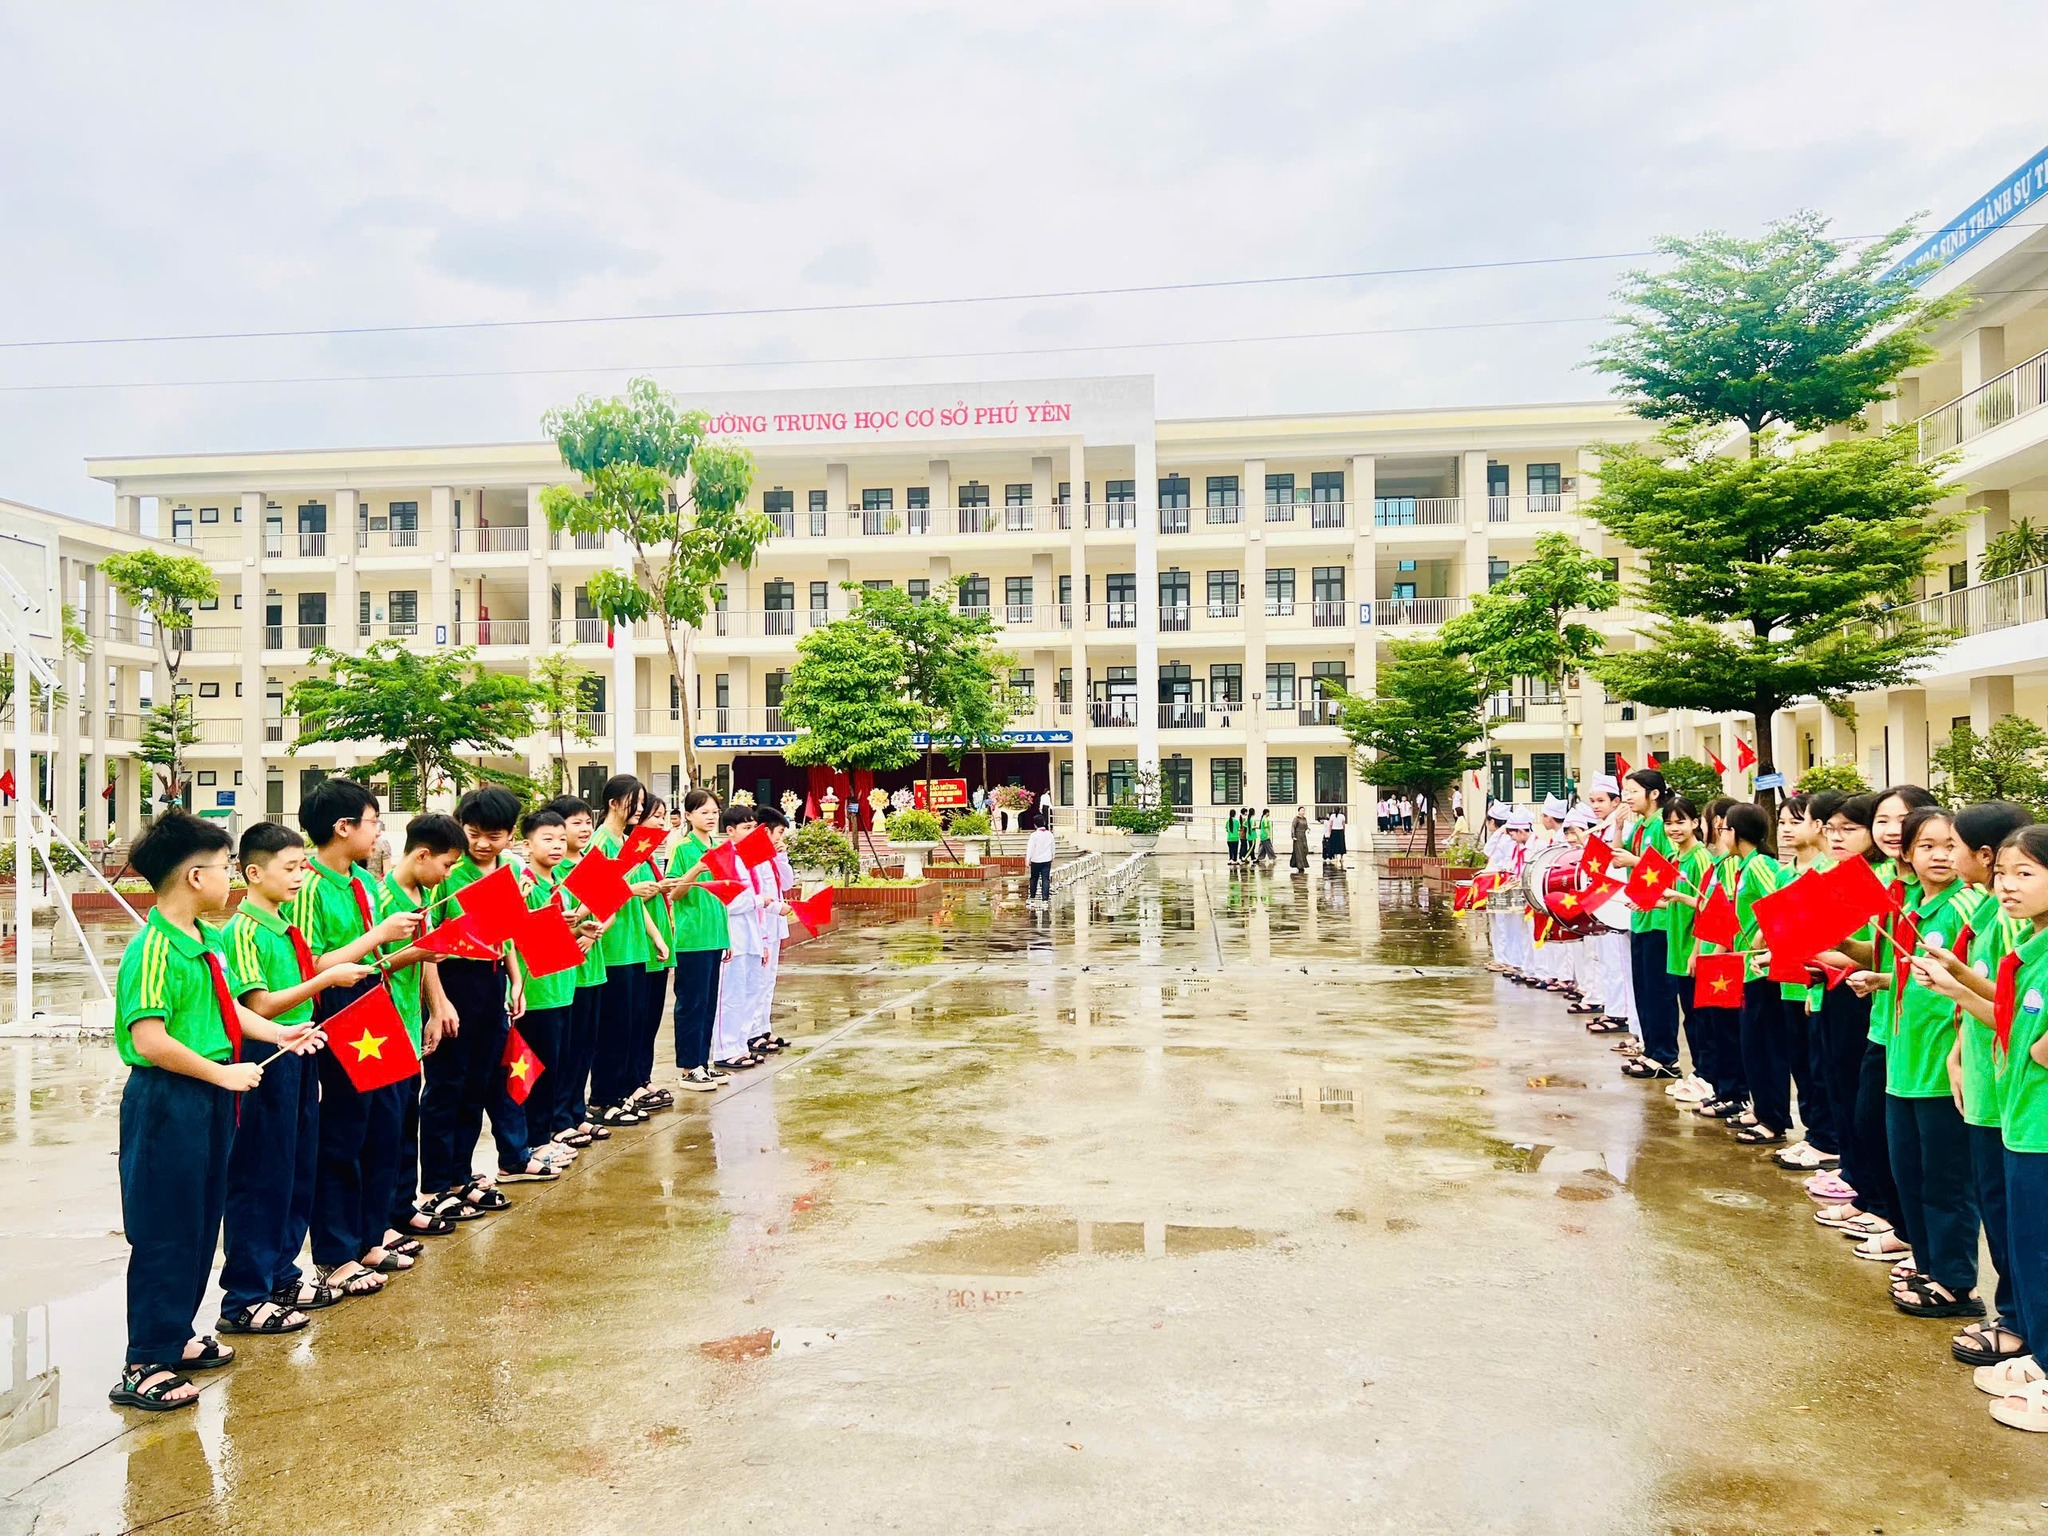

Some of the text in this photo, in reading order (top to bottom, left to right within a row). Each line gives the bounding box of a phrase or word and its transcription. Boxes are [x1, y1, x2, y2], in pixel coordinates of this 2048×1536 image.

[1941, 222, 1967, 255] SINH
[1969, 188, 2012, 239] THÀNH
[2014, 168, 2032, 205] SỰ
[699, 400, 1072, 433] ƯỜNG TRUNG HỌC CƠ SỞ PHÚ YÊN
[1361, 606, 1369, 622] B
[437, 627, 445, 643] B
[763, 734, 793, 746] TÀI
[1014, 733, 1046, 742] GIA
